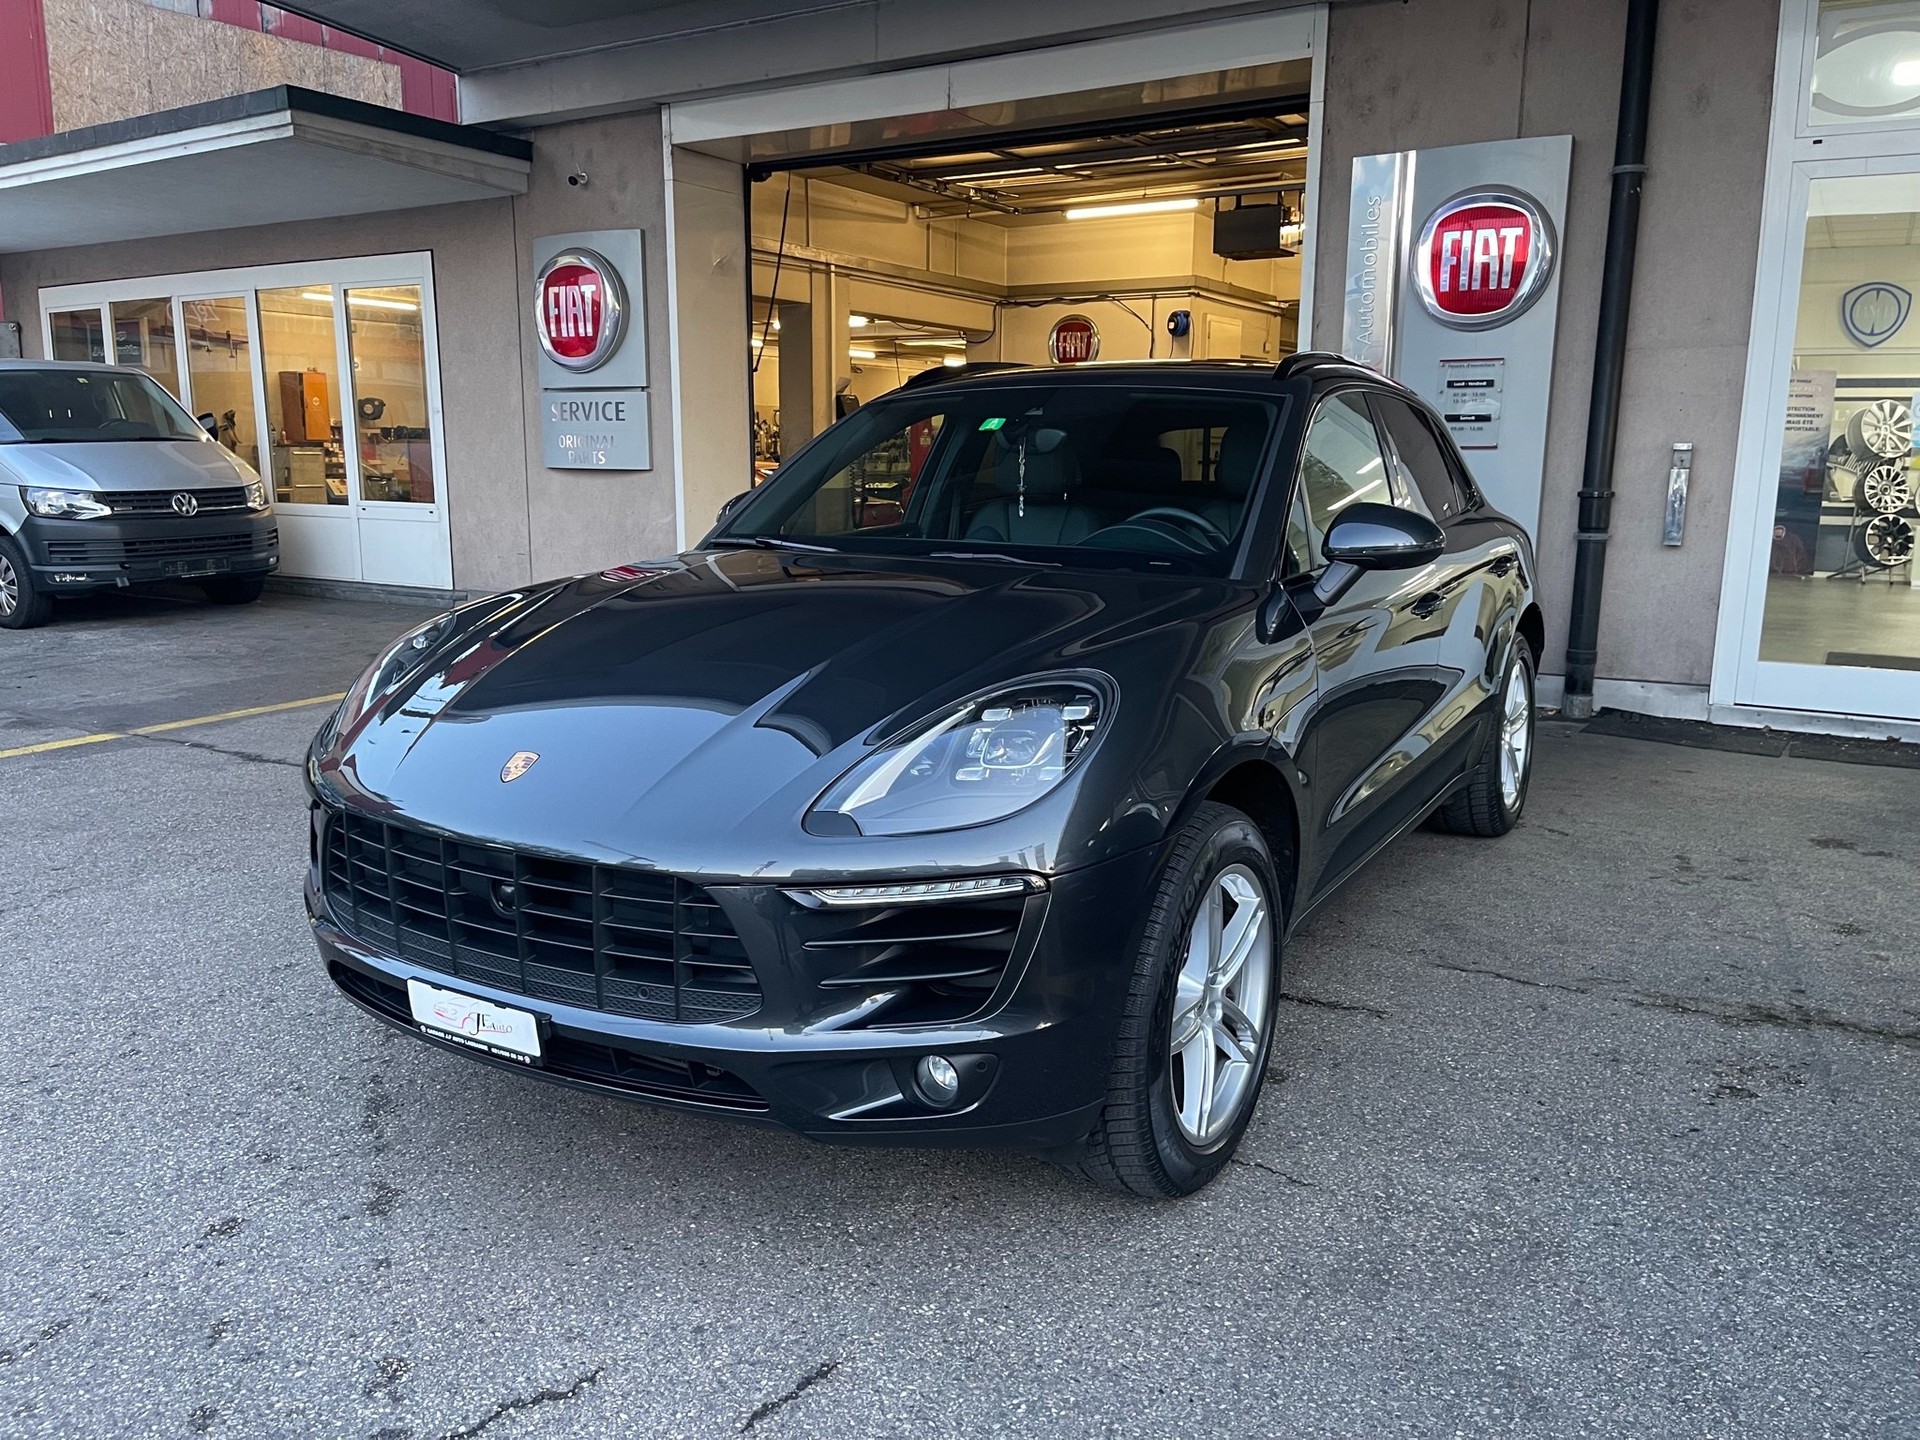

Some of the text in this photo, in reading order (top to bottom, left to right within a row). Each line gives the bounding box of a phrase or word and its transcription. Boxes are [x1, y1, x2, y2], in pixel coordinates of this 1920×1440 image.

[1356, 195, 1382, 345] Automobiles
[1440, 227, 1524, 292] FIAT
[548, 285, 597, 338] FIAT
[1058, 331, 1091, 359] FIAT
[551, 400, 626, 422] SERVICE
[558, 434, 616, 449] ORIGINAL
[567, 450, 606, 465] PARTS
